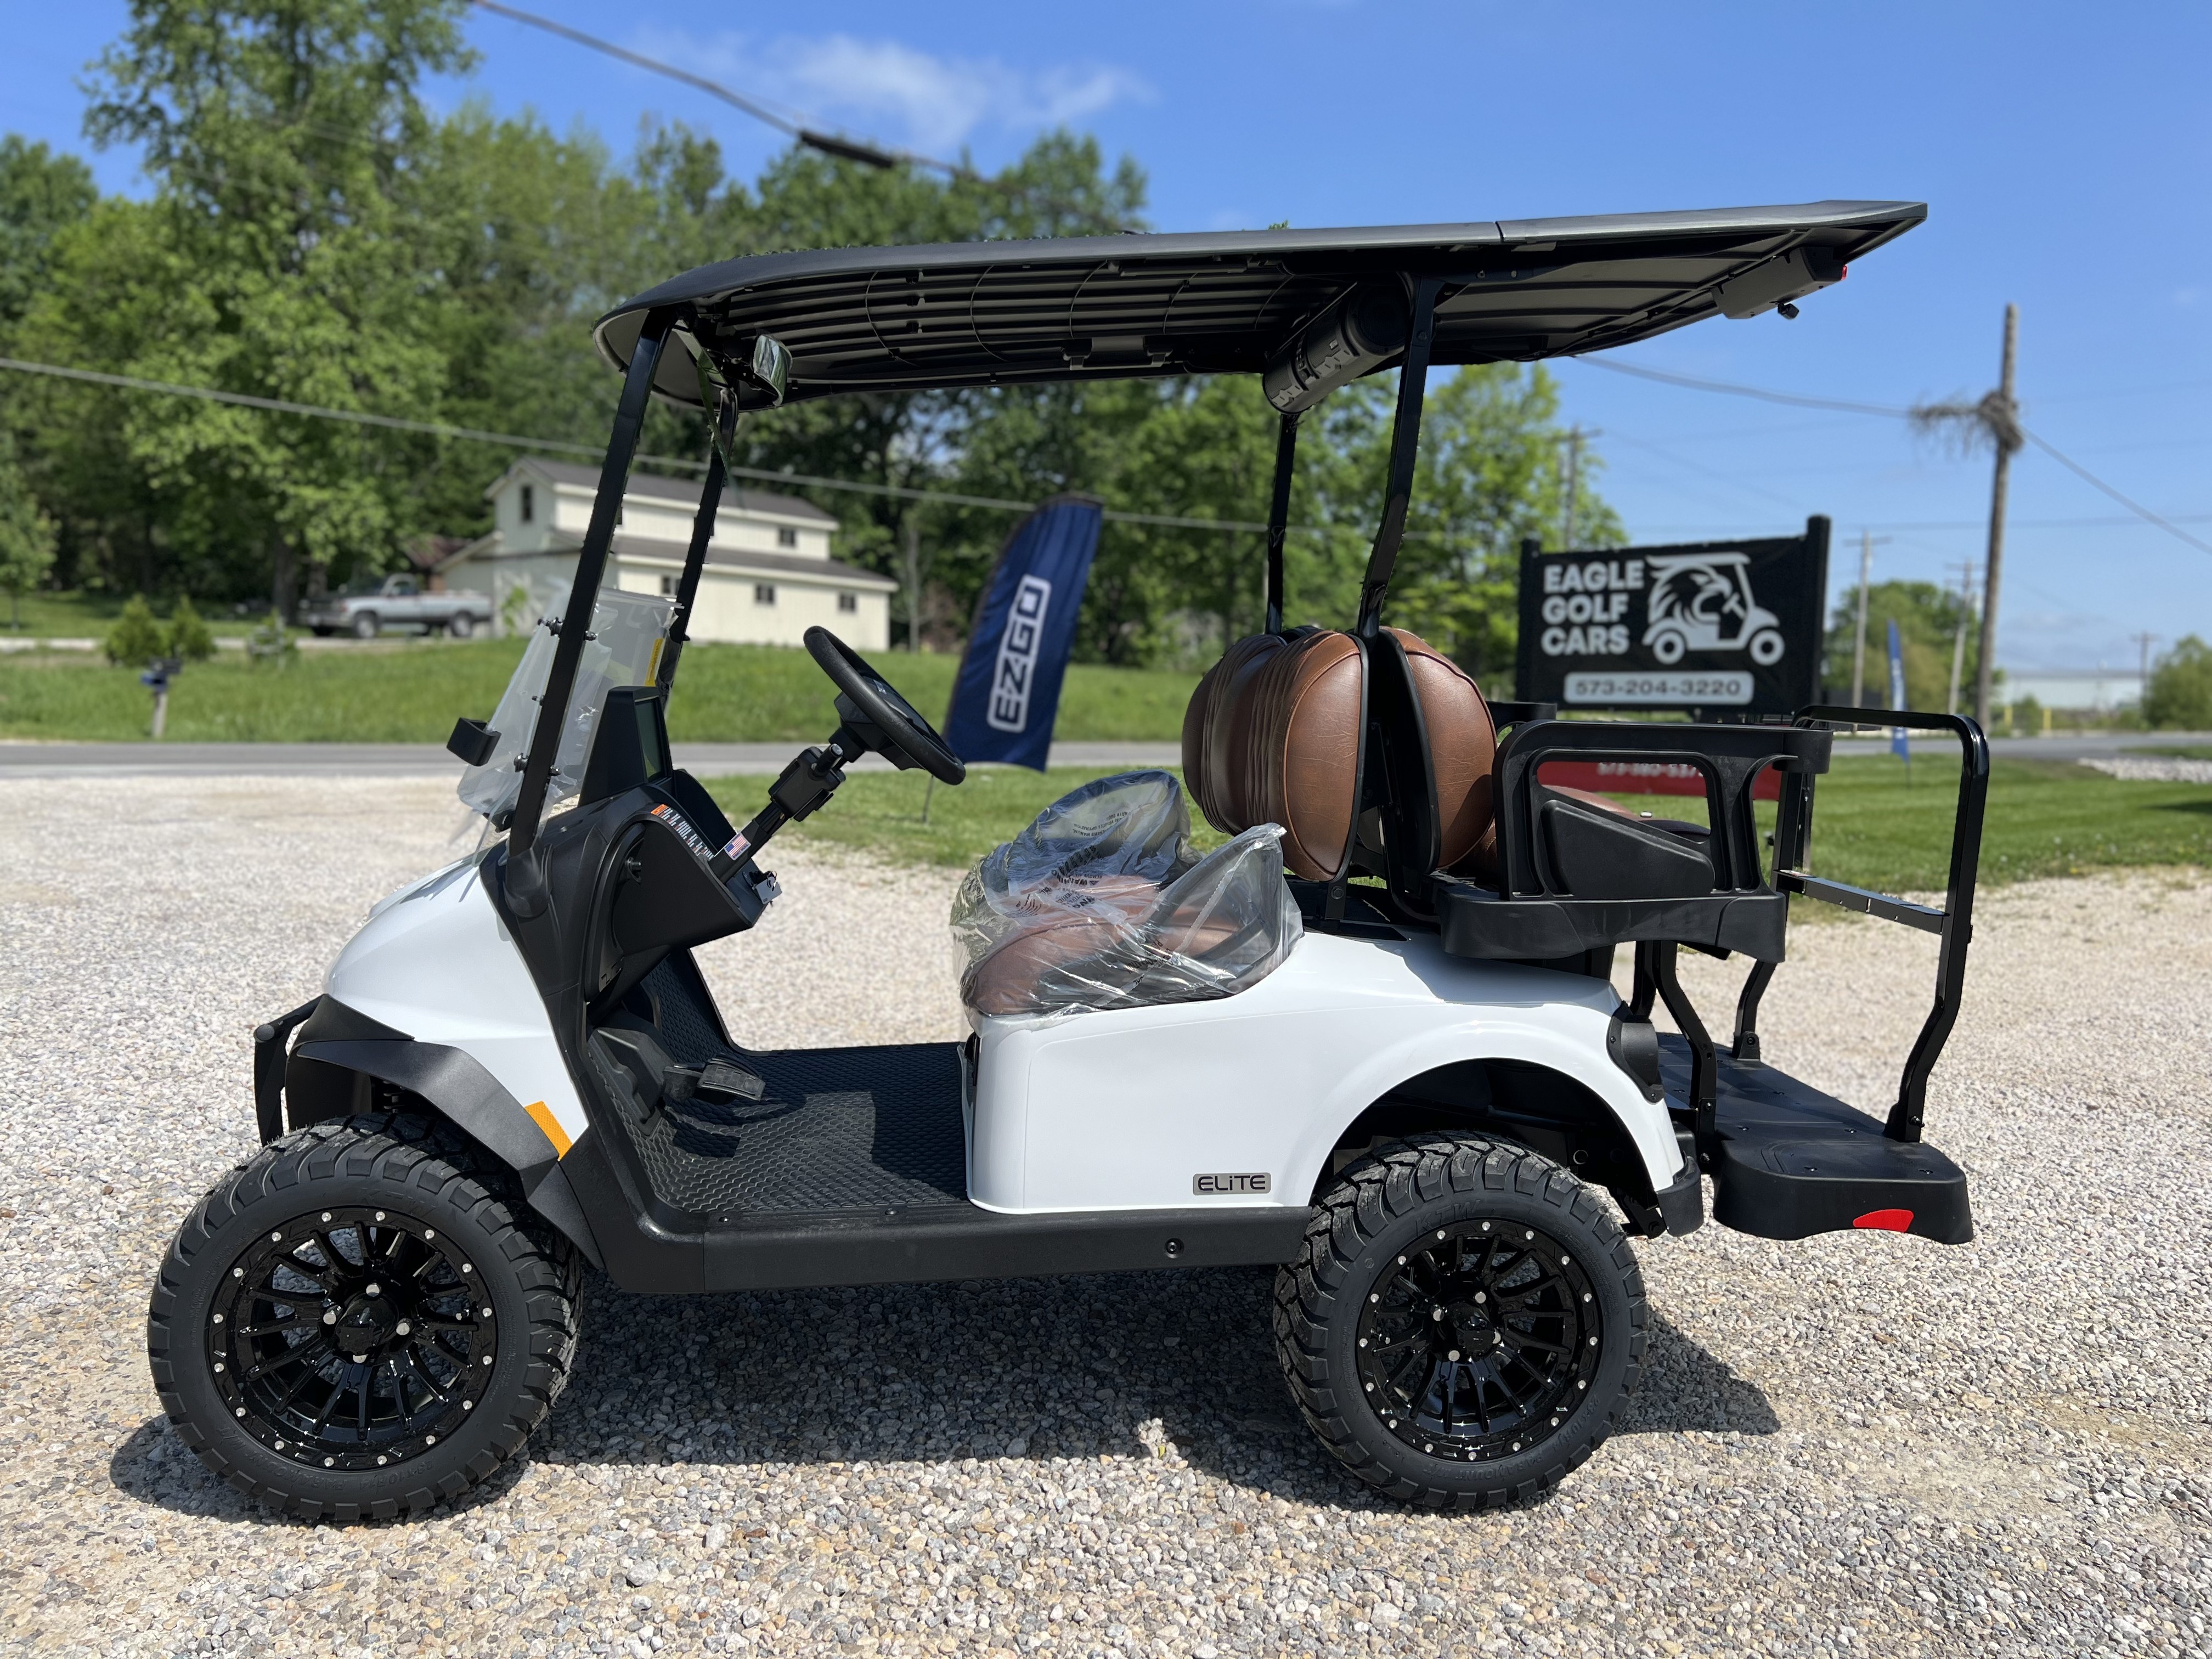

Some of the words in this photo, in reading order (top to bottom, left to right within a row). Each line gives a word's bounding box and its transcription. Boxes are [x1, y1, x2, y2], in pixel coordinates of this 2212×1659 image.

[1544, 560, 1645, 594] EAGLE
[1542, 593, 1629, 624] GOLF
[994, 585, 1045, 725] EZGO
[1541, 625, 1630, 656] CARS
[1576, 678, 1741, 696] 573-204-3220
